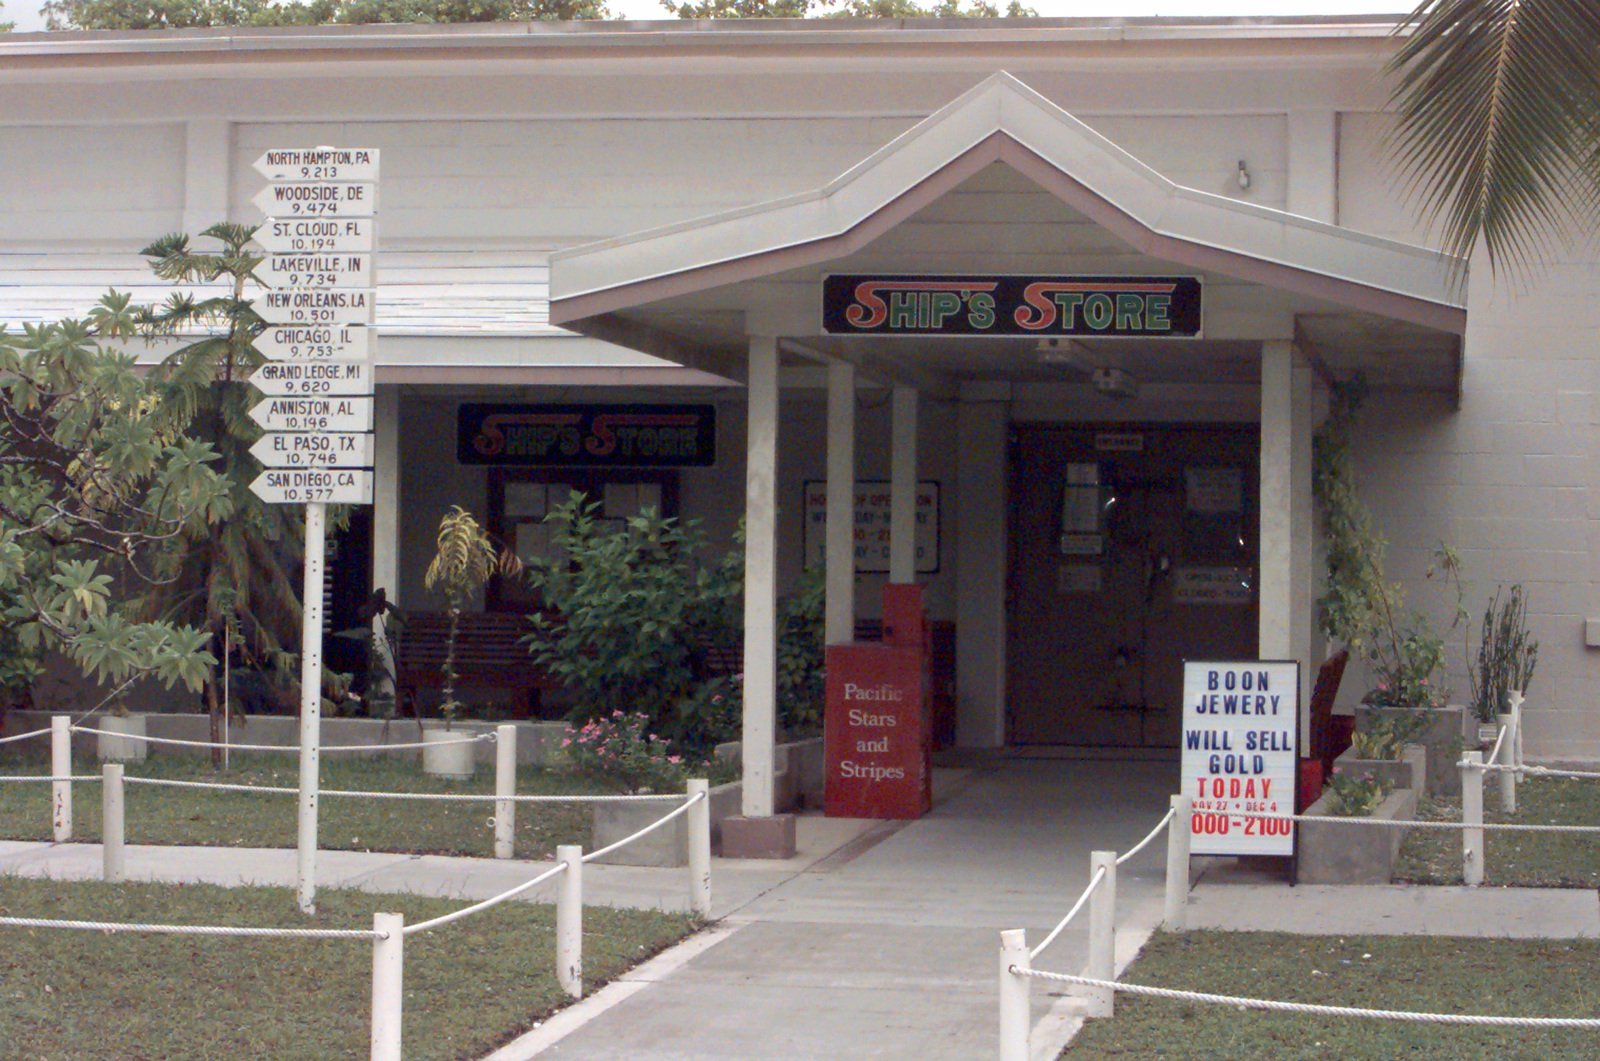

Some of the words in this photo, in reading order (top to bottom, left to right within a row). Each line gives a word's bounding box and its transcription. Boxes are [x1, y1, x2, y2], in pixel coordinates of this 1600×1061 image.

[267, 152, 300, 165] NORTH
[301, 166, 337, 178] 9,213
[274, 187, 344, 201] WOODSIDE,
[347, 186, 363, 200] DE
[292, 203, 337, 214] 9,474
[273, 223, 291, 236] ST.
[346, 222, 361, 235] FL
[272, 258, 345, 272] LAKEVILLE,
[348, 258, 361, 271] IN
[267, 293, 291, 307] NEW
[846, 281, 998, 328] SHIP'S
[1013, 282, 1177, 329] STORE
[341, 330, 352, 343] IL
[262, 366, 302, 379] GRAND
[285, 381, 330, 393] 9,620
[270, 401, 335, 416] ANNISTON,
[337, 401, 354, 415] AL
[273, 437, 287, 451] EL
[294, 437, 335, 451] PASO,
[338, 437, 355, 451] TX
[286, 453, 337, 464] 10,746
[267, 473, 290, 486] SAN
[338, 473, 355, 486] CA
[1207, 670, 1268, 691] BOON
[844, 683, 903, 701] Pacific
[1196, 694, 1280, 715] JEWERY
[848, 709, 897, 727] Stars
[856, 736, 889, 753] and
[1186, 730, 1232, 751] WILL
[1246, 730, 1292, 751] SELL
[840, 760, 905, 782] Stripes
[1209, 754, 1264, 774] GOLD
[1197, 777, 1271, 799] TODAY
[1246, 801, 1265, 812] DEC
